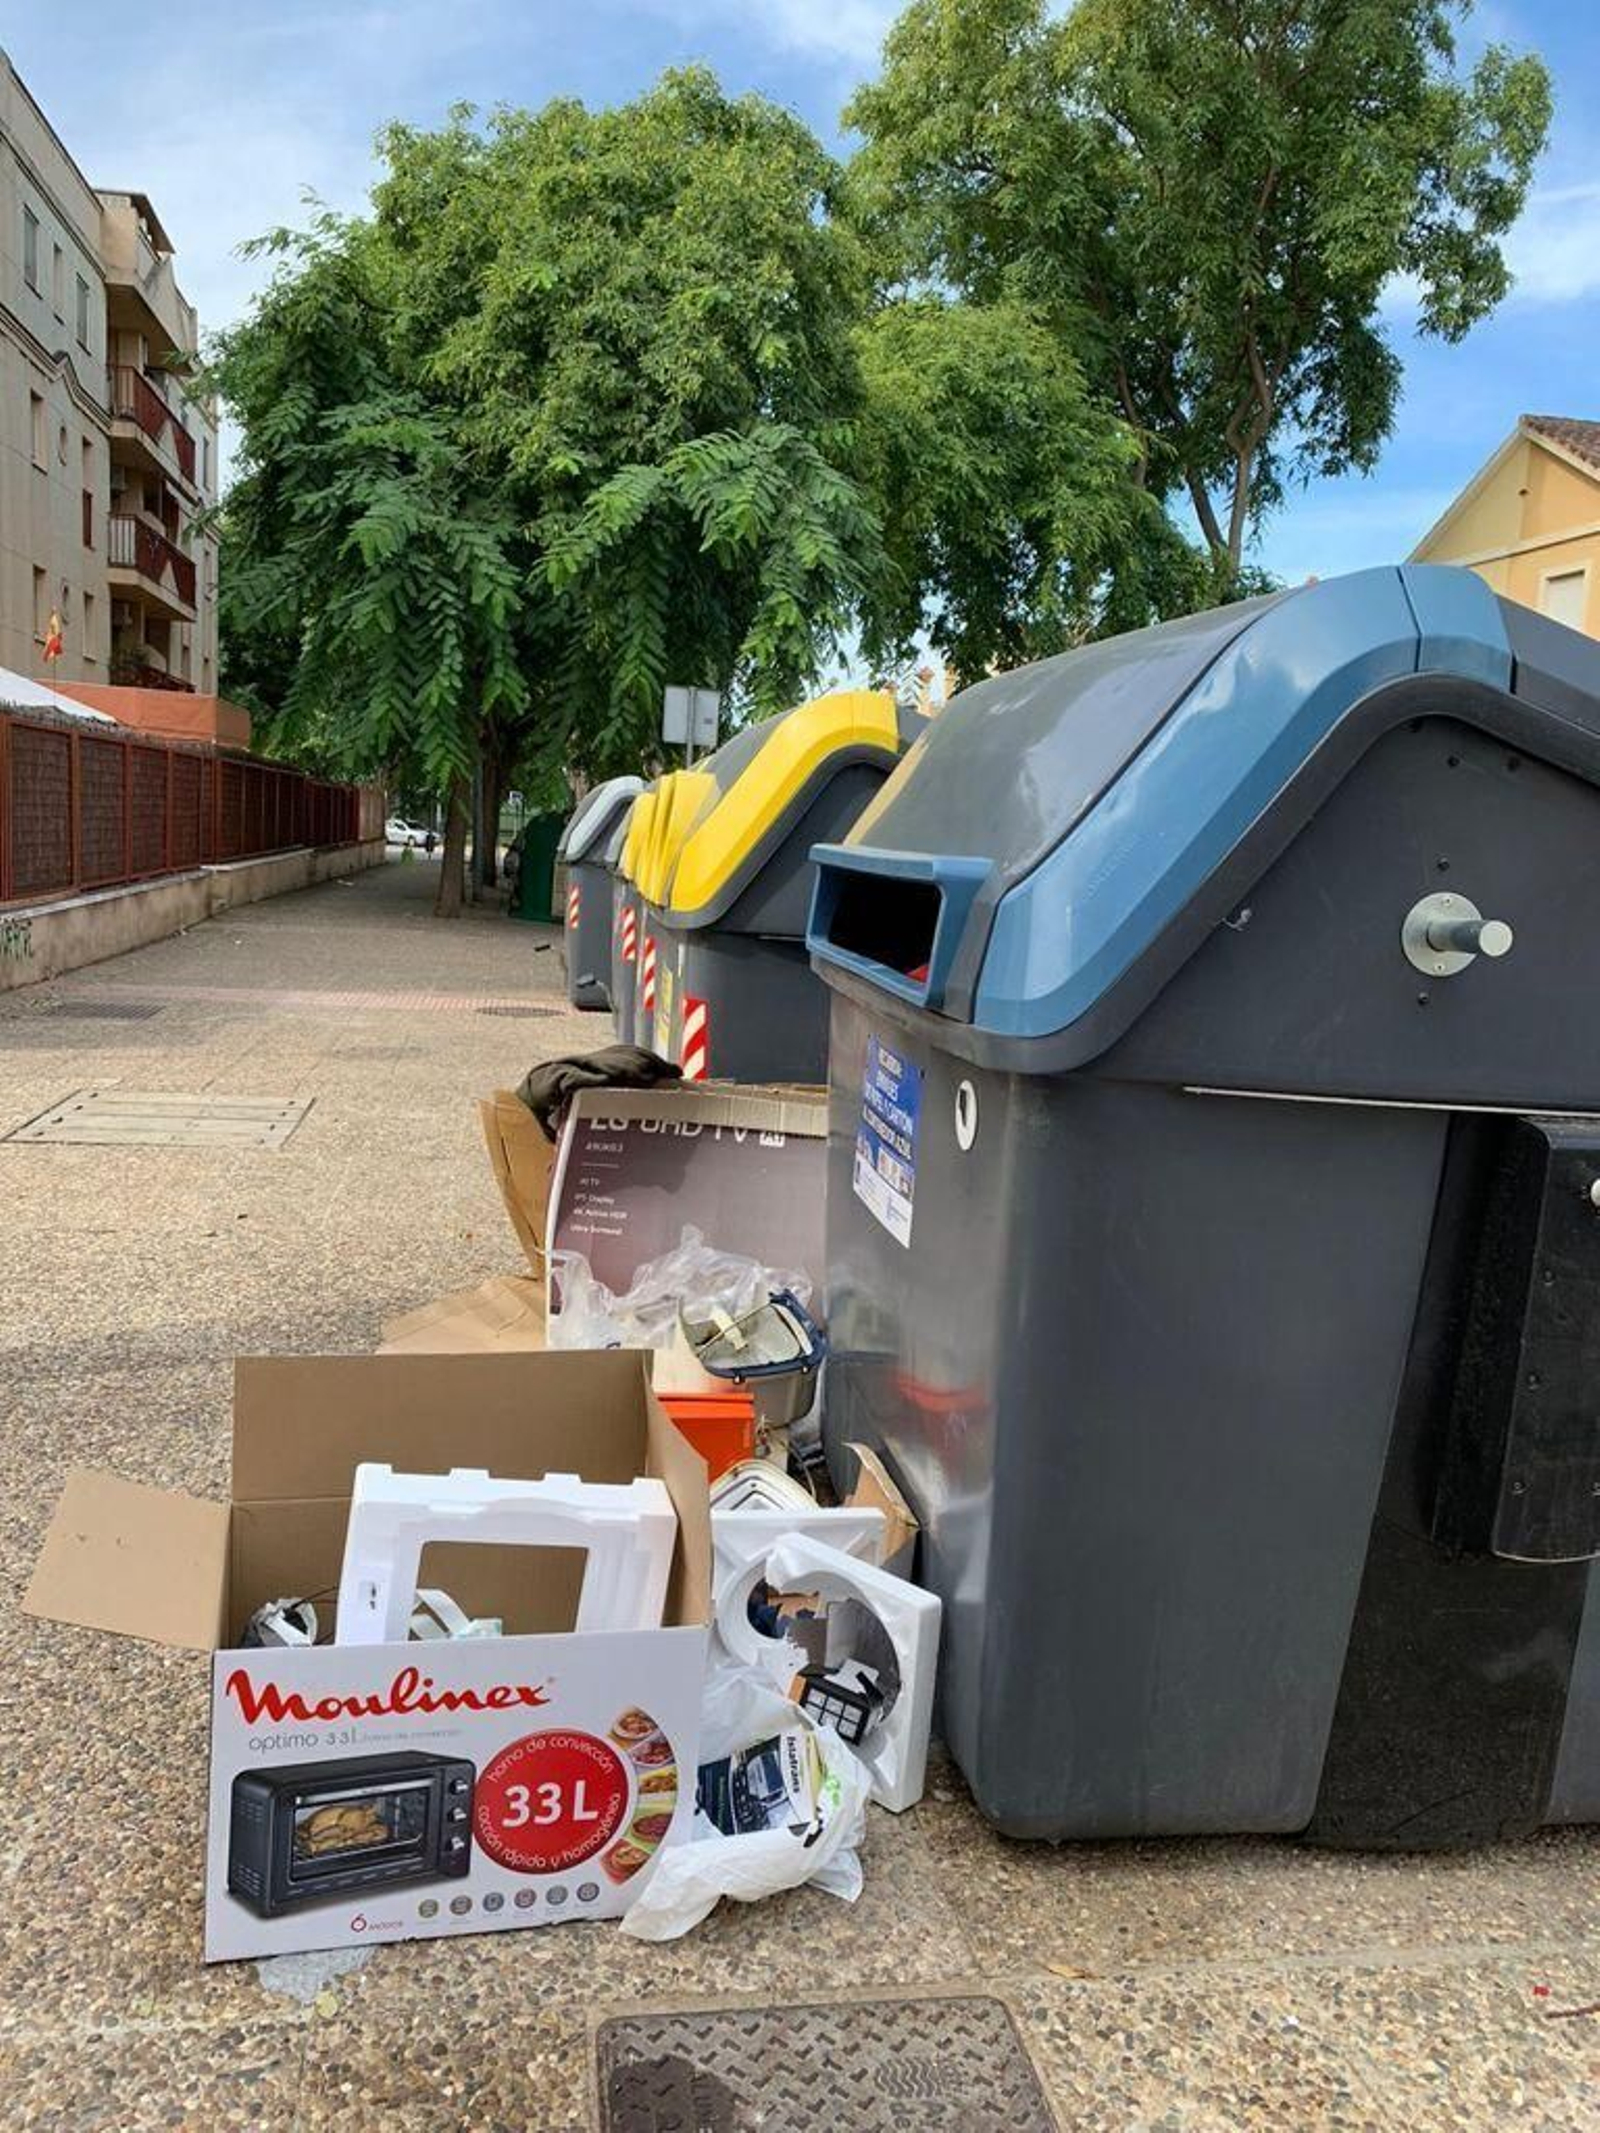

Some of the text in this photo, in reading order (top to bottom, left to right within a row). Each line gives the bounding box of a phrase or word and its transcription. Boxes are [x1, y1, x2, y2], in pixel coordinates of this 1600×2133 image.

[226, 1666, 551, 1725] Moulinex
[250, 1732, 318, 1754] optimo
[487, 1736, 616, 1783] horno de convección
[478, 1804, 502, 1852] cocción
[551, 1856, 560, 1868] y
